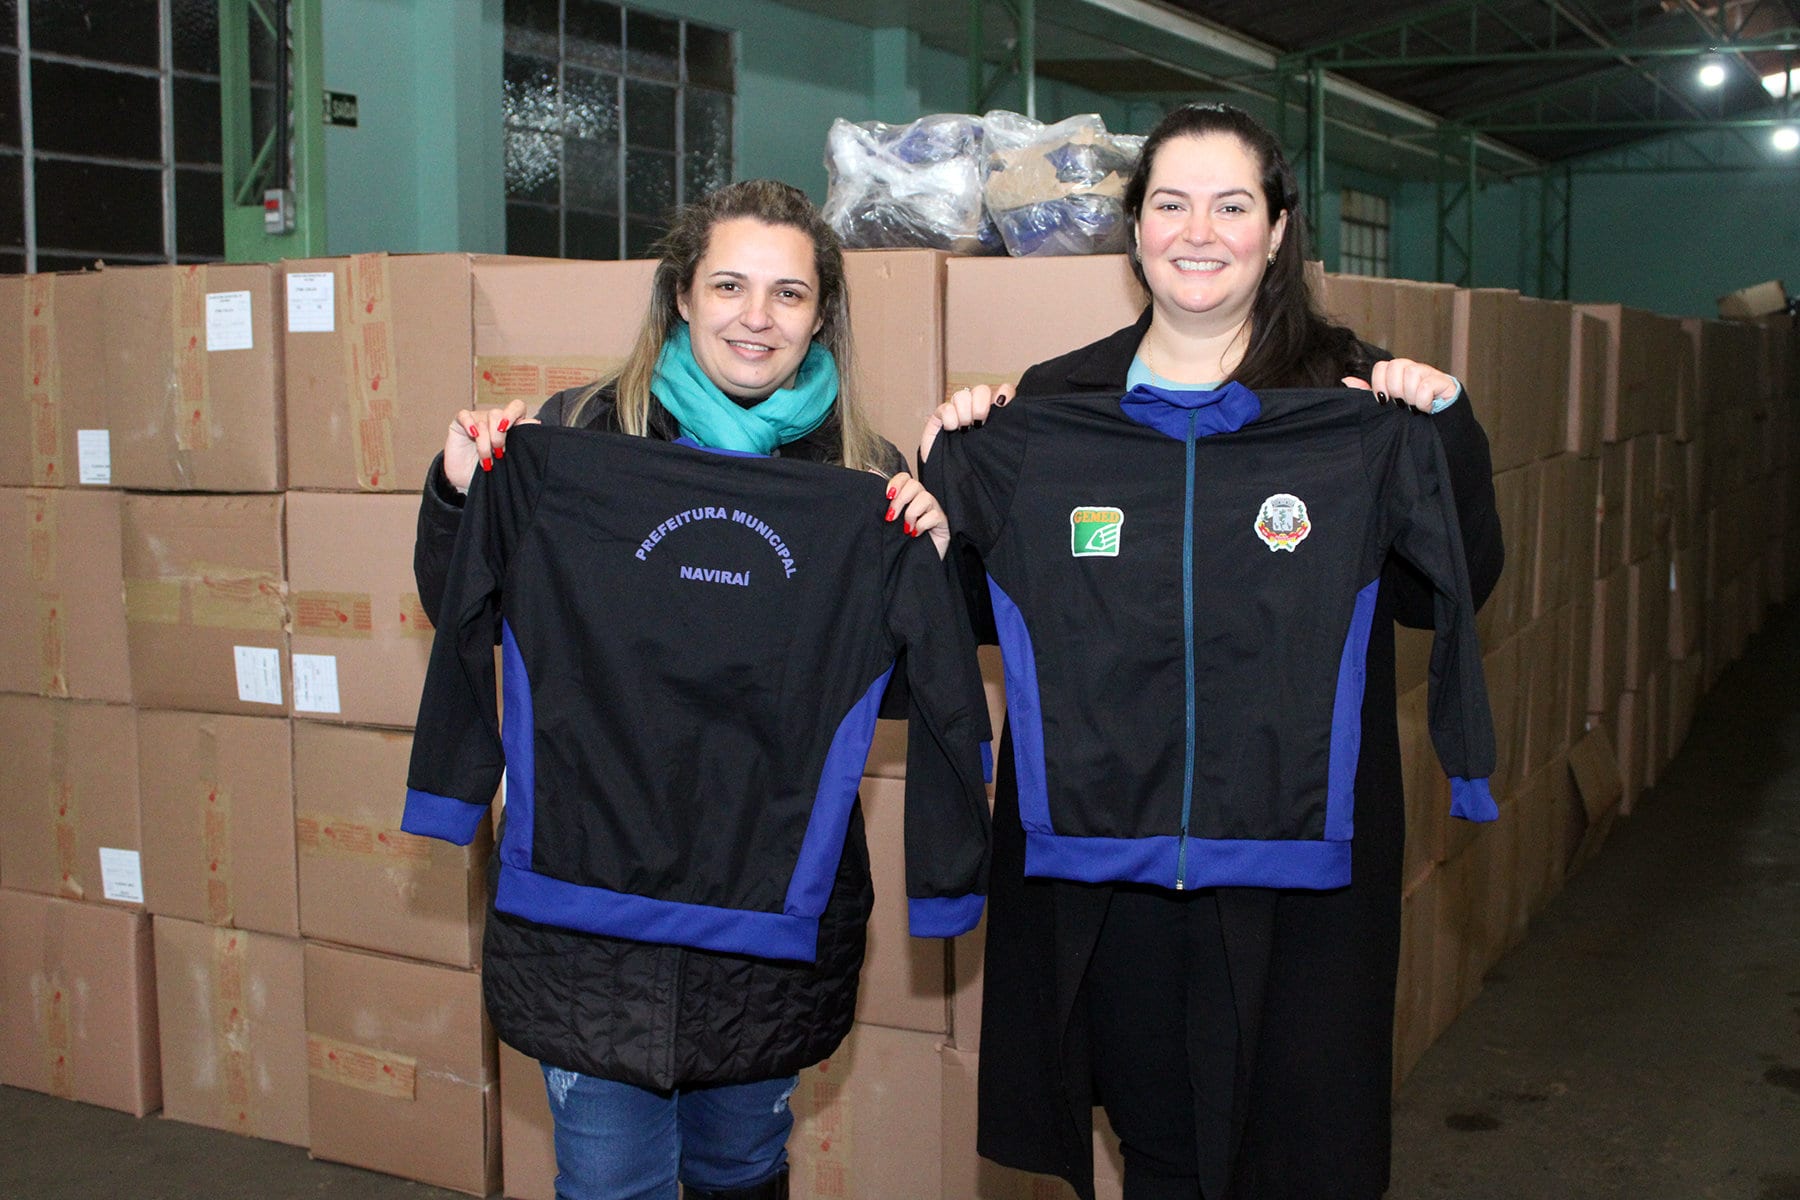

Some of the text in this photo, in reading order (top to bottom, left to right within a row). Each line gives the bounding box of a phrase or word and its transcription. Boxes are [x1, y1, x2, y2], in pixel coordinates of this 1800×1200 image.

[635, 506, 797, 579] PREFEITURA MUNICIPAL
[680, 565, 750, 586] NAVIRAÍ
